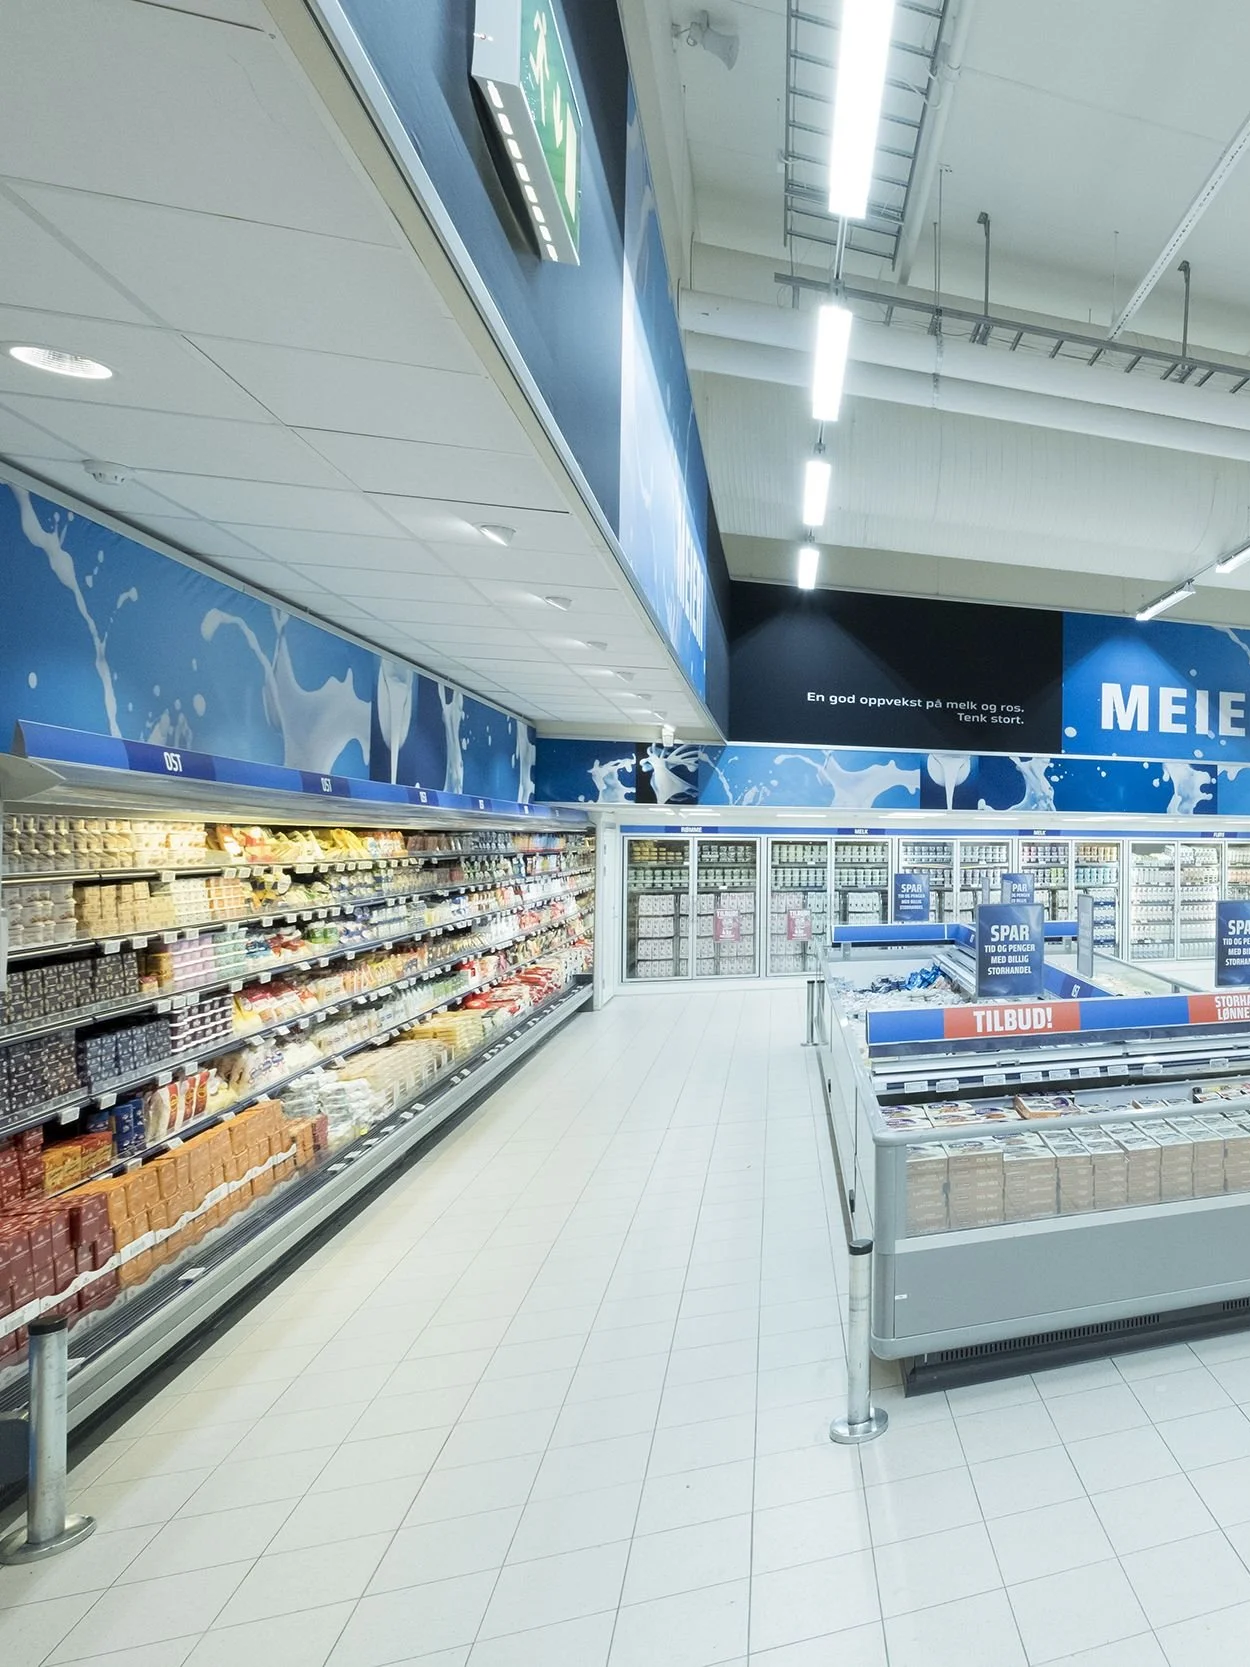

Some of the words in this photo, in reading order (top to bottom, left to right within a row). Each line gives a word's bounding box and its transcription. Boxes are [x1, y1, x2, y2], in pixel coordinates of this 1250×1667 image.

[807, 692, 825, 702] En
[829, 693, 855, 706] god
[859, 696, 922, 708] oppvekst
[926, 697, 942, 710] på
[946, 700, 977, 711] melk
[981, 703, 997, 714] og
[1000, 704, 1024, 713] ros.
[957, 711, 987, 723] Tenk
[991, 713, 1024, 724] stort.
[163, 751, 183, 772] OST
[320, 777, 333, 793] OST
[901, 883, 922, 893] SPAR
[1012, 883, 1028, 892] PAR
[990, 924, 1030, 941] SPAR
[1223, 938, 1233, 946] TID
[984, 944, 996, 953] TID
[997, 944, 1007, 953] OG
[1008, 943, 1036, 953] PENGER
[1228, 948, 1241, 956] MED
[990, 955, 1007, 964] MED
[1008, 954, 1029, 964] BILLIG
[987, 965, 1032, 976] STORHANDEL
[973, 1007, 1052, 1033] TILBUD!
